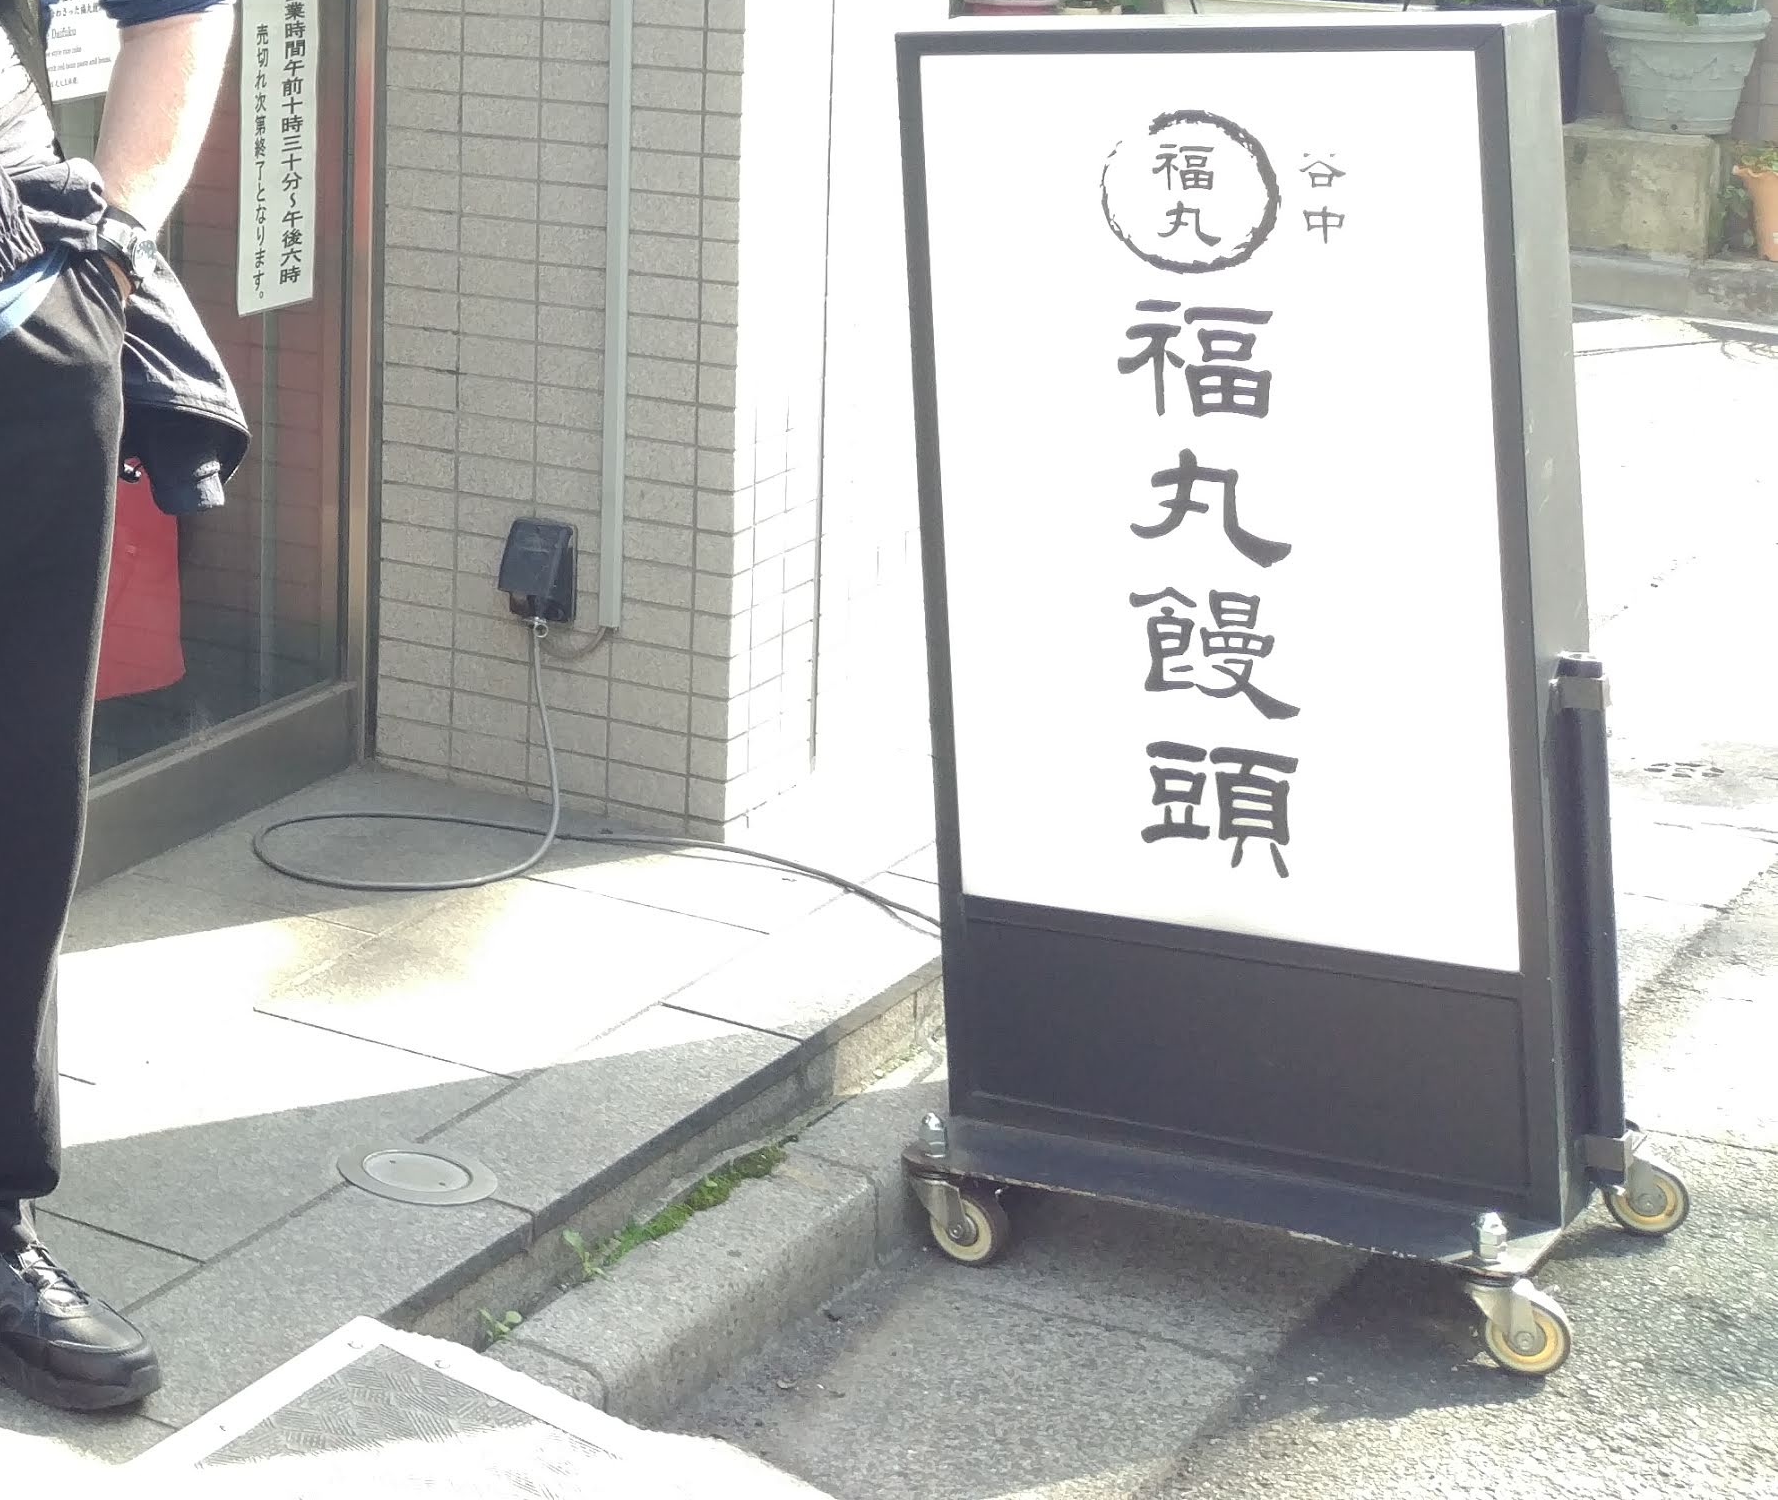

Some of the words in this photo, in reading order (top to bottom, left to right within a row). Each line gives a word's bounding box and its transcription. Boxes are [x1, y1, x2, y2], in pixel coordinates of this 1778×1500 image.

[251, 23, 269, 299] 売切れ次第終了となります。
[1153, 143, 1221, 247] 福丸
[1298, 152, 1347, 244] 谷中
[1117, 298, 1300, 879] 福丸饅頭
